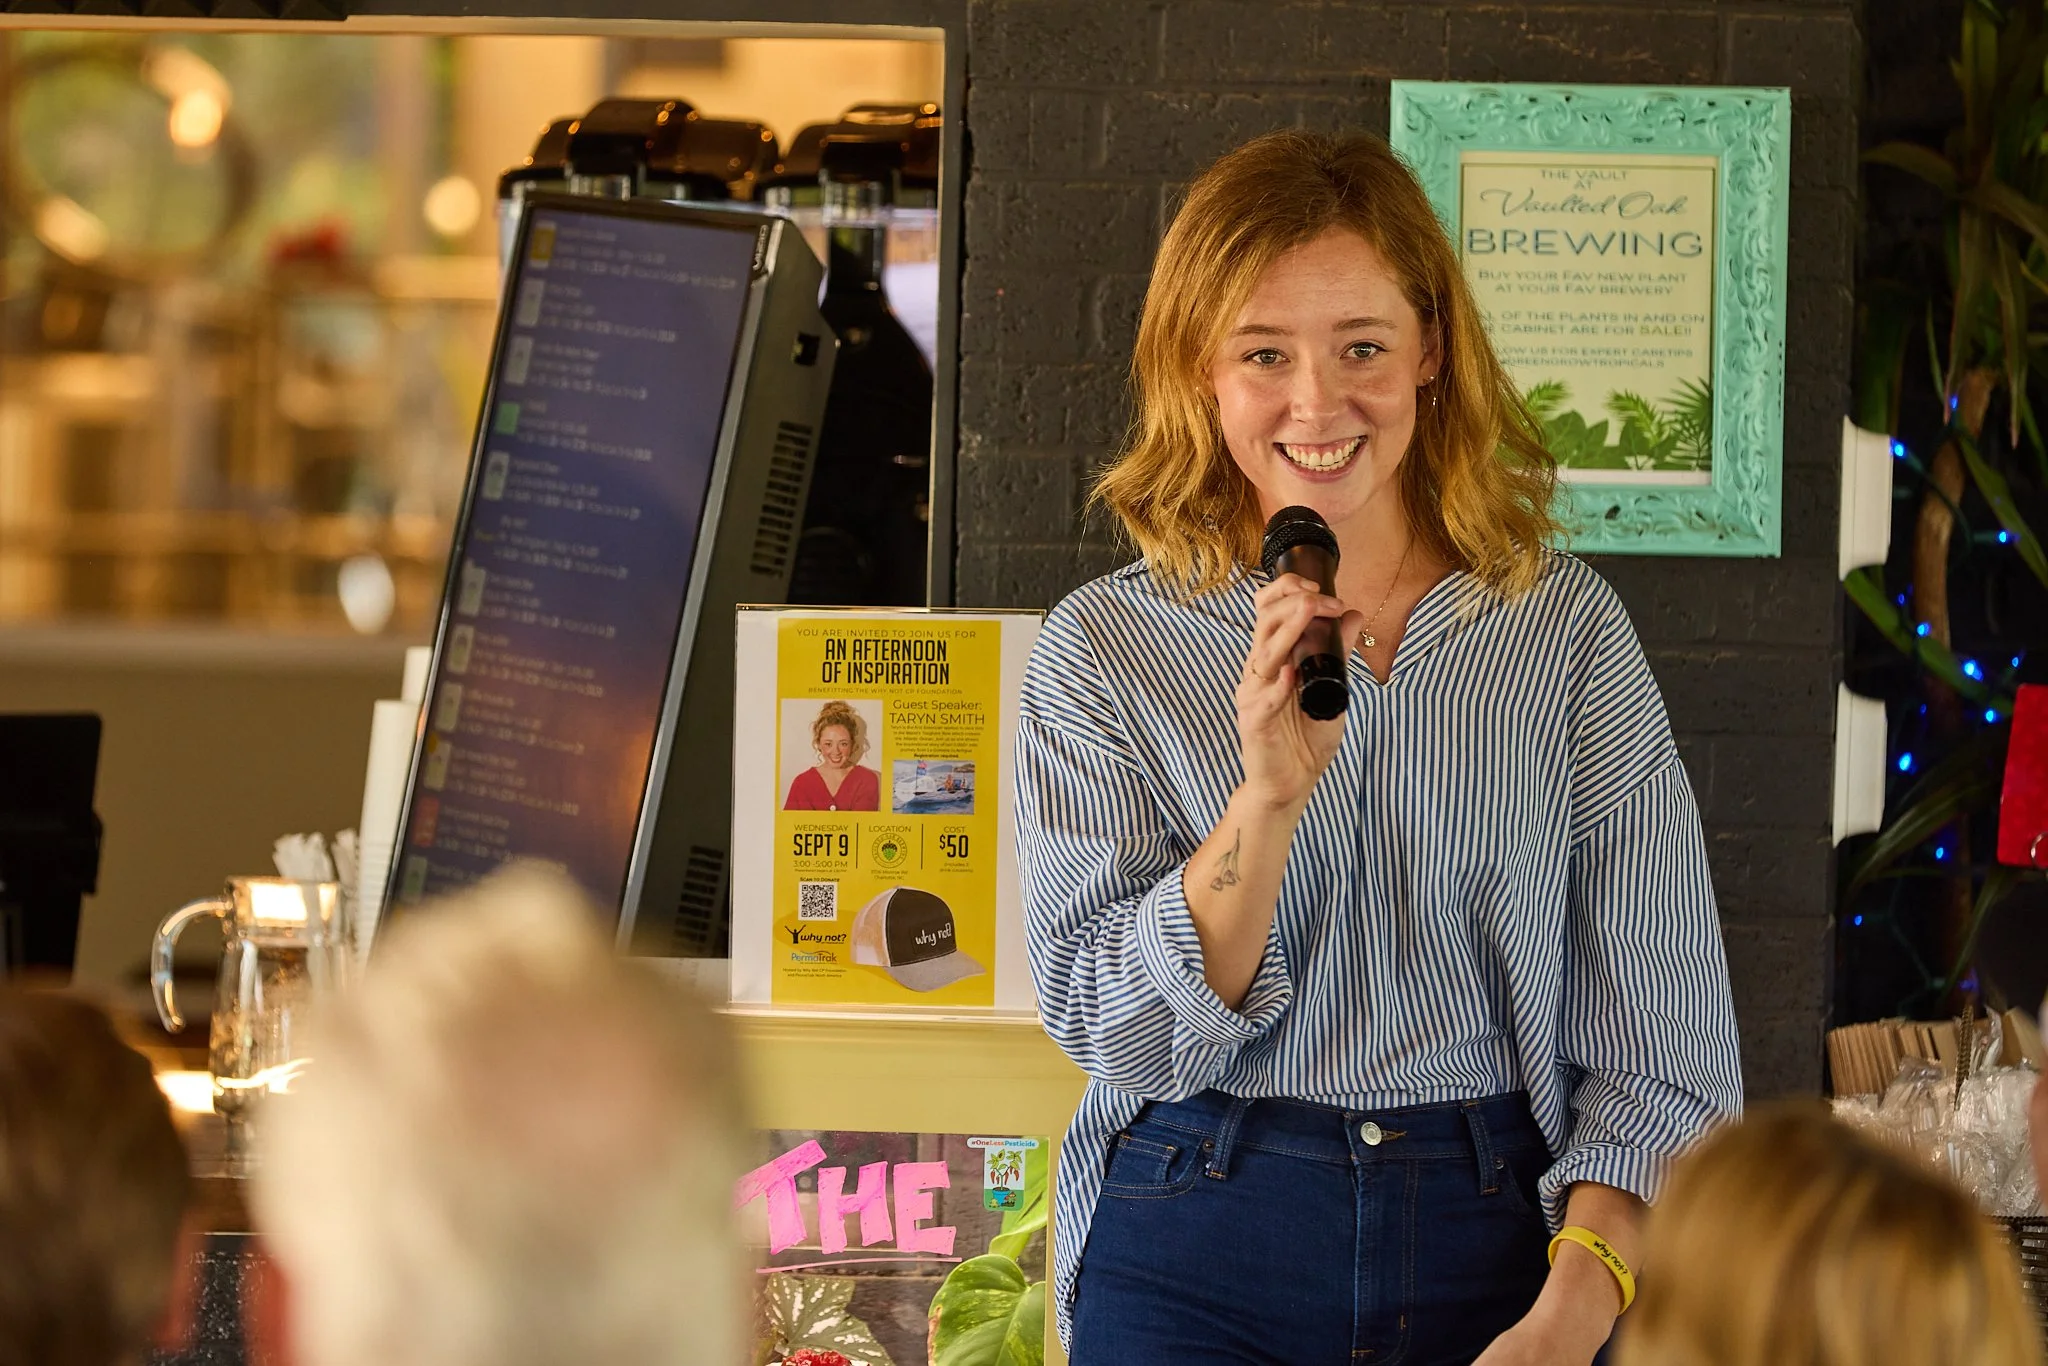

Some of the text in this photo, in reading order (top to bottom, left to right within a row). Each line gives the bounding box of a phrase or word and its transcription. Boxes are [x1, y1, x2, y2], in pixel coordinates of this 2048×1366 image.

[1541, 169, 1628, 181] THE VAULT
[1574, 181, 1593, 190] AT
[1480, 187, 1688, 220] Vaulted Oak
[1469, 228, 1703, 258] BREWING
[1598, 272, 1630, 282] NEW
[1638, 273, 1688, 283] PLANT
[1495, 283, 1512, 293] AT
[1600, 285, 1673, 295] BREWERY
[1501, 311, 1522, 320] OF
[1526, 312, 1554, 321] THE
[1559, 312, 1619, 323] PLANTS
[1623, 313, 1638, 323] IN
[1643, 313, 1676, 323] AND
[1682, 314, 1705, 323] ON
[1501, 324, 1565, 334] CABINET
[1569, 324, 1599, 335] ARE
[1604, 325, 1634, 335] FOR
[1581, 348, 1628, 357] EXPERT
[797, 629, 818, 637] YOU
[822, 629, 842, 637] ARE
[846, 629, 888, 638] INVITED
[892, 630, 905, 638] TO
[909, 630, 933, 638] JOIN
[955, 630, 976, 639] FOR
[825, 639, 947, 662] AN AFTERNOON
[822, 662, 950, 685] OF INSPIRATION
[893, 699, 983, 713] Guest Speaker:
[889, 713, 985, 725] TARYN SMITH
[794, 824, 849, 832] WEDNESDAY
[868, 825, 911, 833] LOCATION
[793, 834, 834, 857] SEPT
[838, 834, 849, 857] 9
[939, 834, 969, 858] $50
[793, 860, 811, 868] 3:00
[800, 933, 822, 943] why
[915, 923, 952, 946] why not?
[791, 952, 837, 962] PermaTrak
[732, 1139, 957, 1256] THE
[1593, 1240, 1629, 1275] why not?
